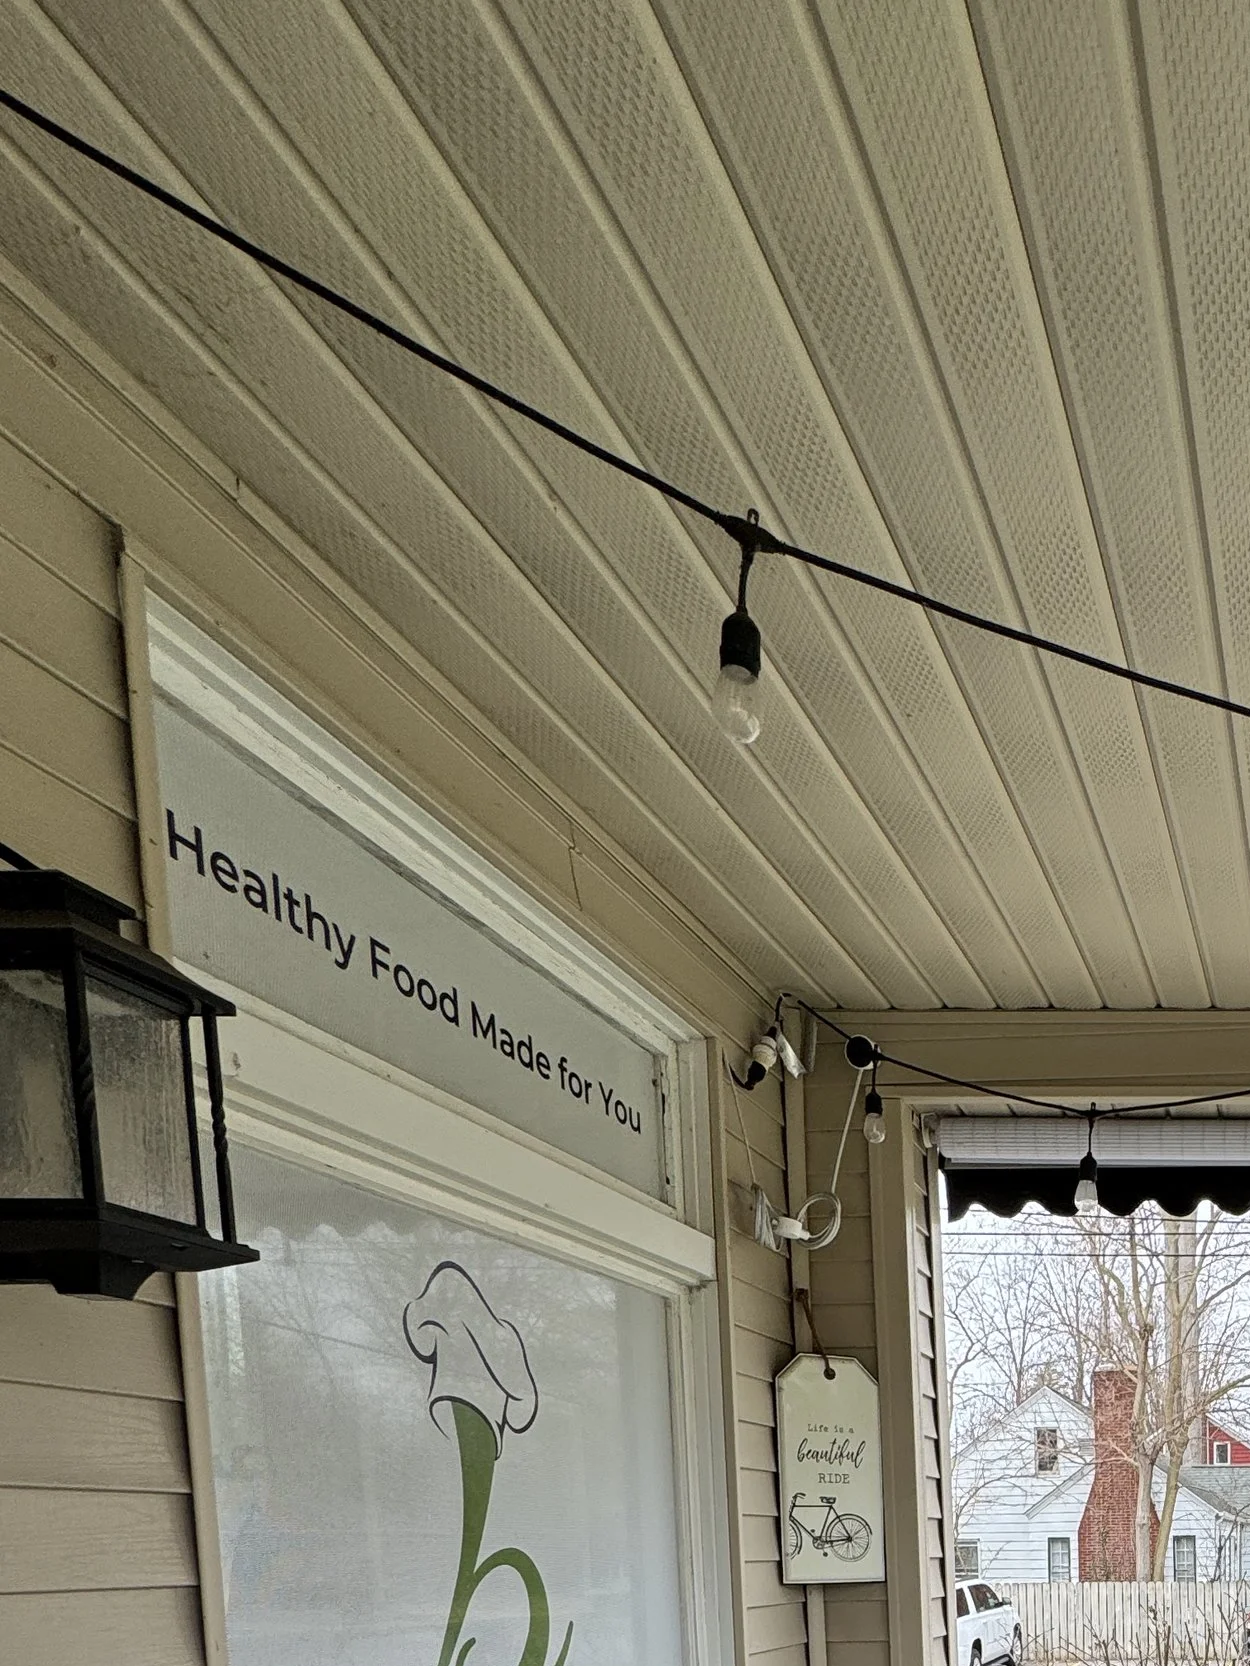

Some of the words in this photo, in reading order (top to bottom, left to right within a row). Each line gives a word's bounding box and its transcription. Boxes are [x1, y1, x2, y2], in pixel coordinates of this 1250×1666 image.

[165, 808, 356, 970] Healthy
[369, 936, 460, 1027] Food
[470, 1000, 551, 1080] Made
[558, 1056, 593, 1105] for
[598, 1081, 642, 1134] You
[807, 1423, 829, 1433] Life
[834, 1424, 844, 1433] is
[797, 1437, 866, 1469] beautiful
[817, 1472, 850, 1485] RIDE
